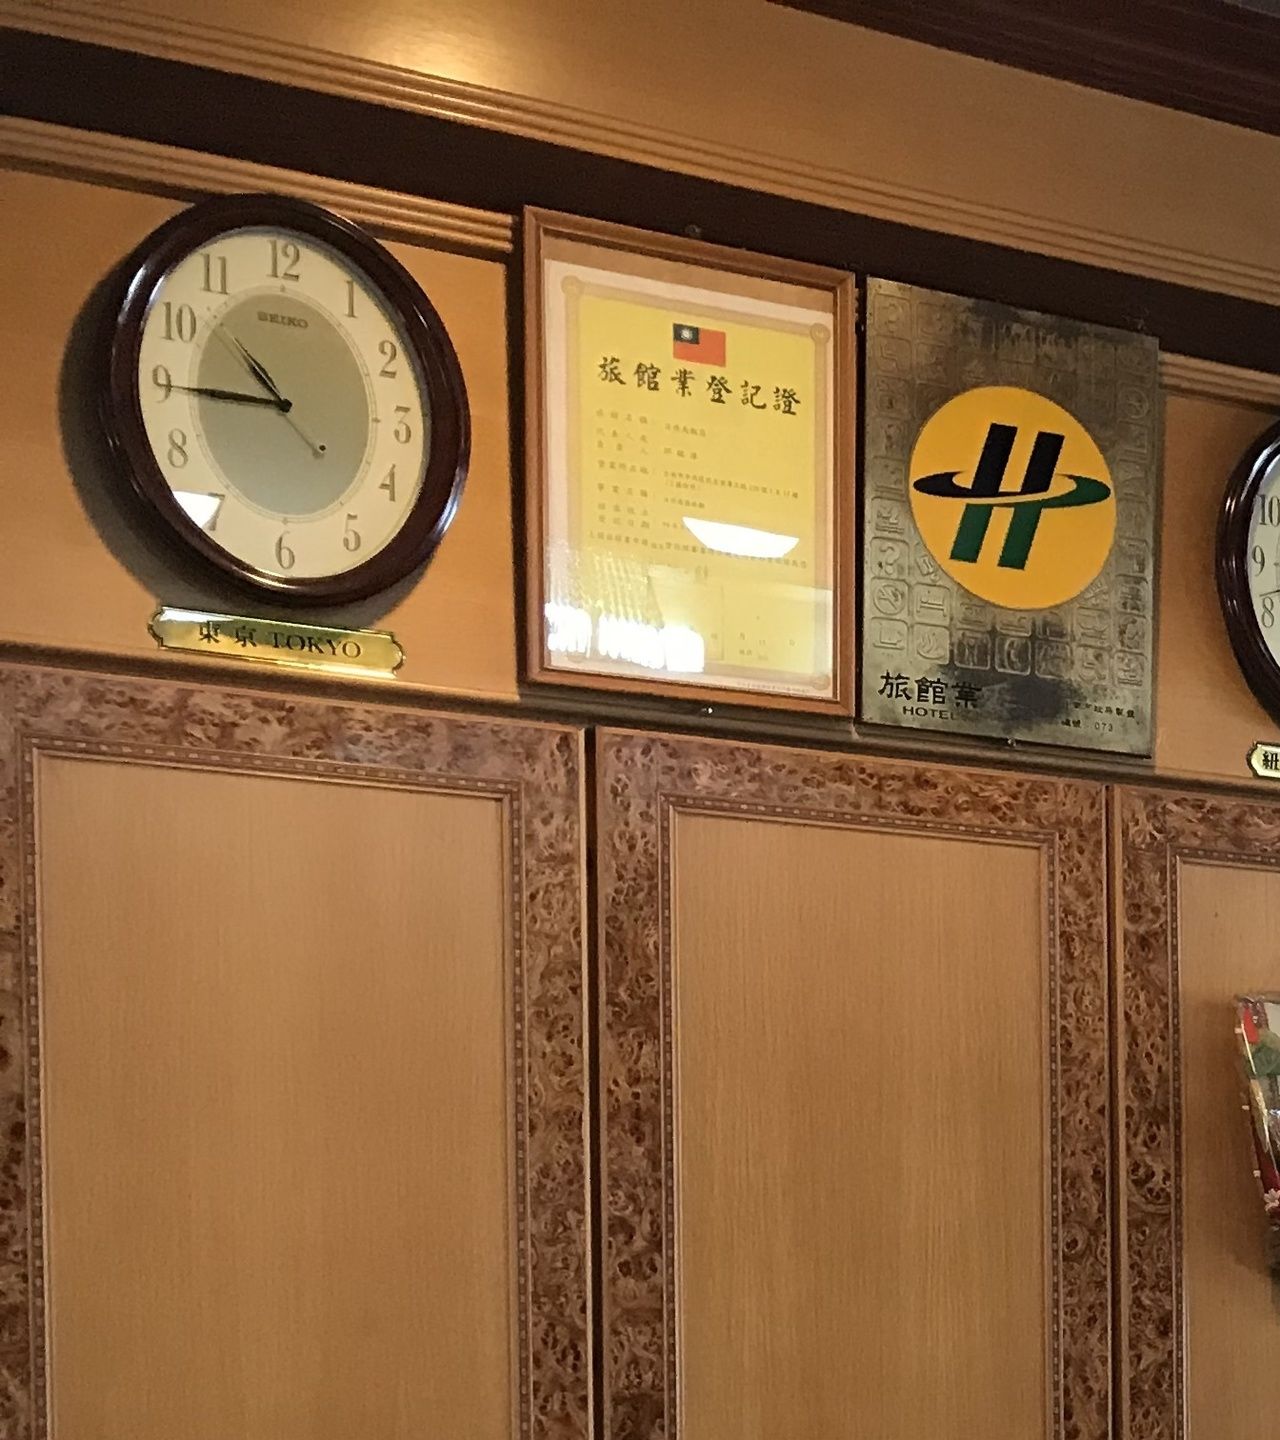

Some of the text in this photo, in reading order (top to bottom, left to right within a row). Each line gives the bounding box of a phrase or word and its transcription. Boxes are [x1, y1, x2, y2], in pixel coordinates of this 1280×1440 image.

[202, 253, 230, 295] 11
[269, 240, 300, 282] 12
[345, 280, 358, 317] 1
[161, 302, 197, 344] 10
[257, 311, 309, 329] SEIKO
[378, 341, 397, 379] 2
[152, 365, 175, 402] 9
[597, 356, 801, 417] 旅館業登記證
[394, 405, 411, 443] 3
[168, 429, 188, 469] 8
[379, 464, 396, 502] 4
[1259, 495, 1280, 527] 10
[275, 531, 295, 569] 6
[343, 513, 361, 552] 5
[1252, 545, 1265, 577] 9
[1261, 597, 1274, 628] 8
[199, 623, 361, 659] 東京 TOKYO
[878, 670, 981, 708] 旅館業
